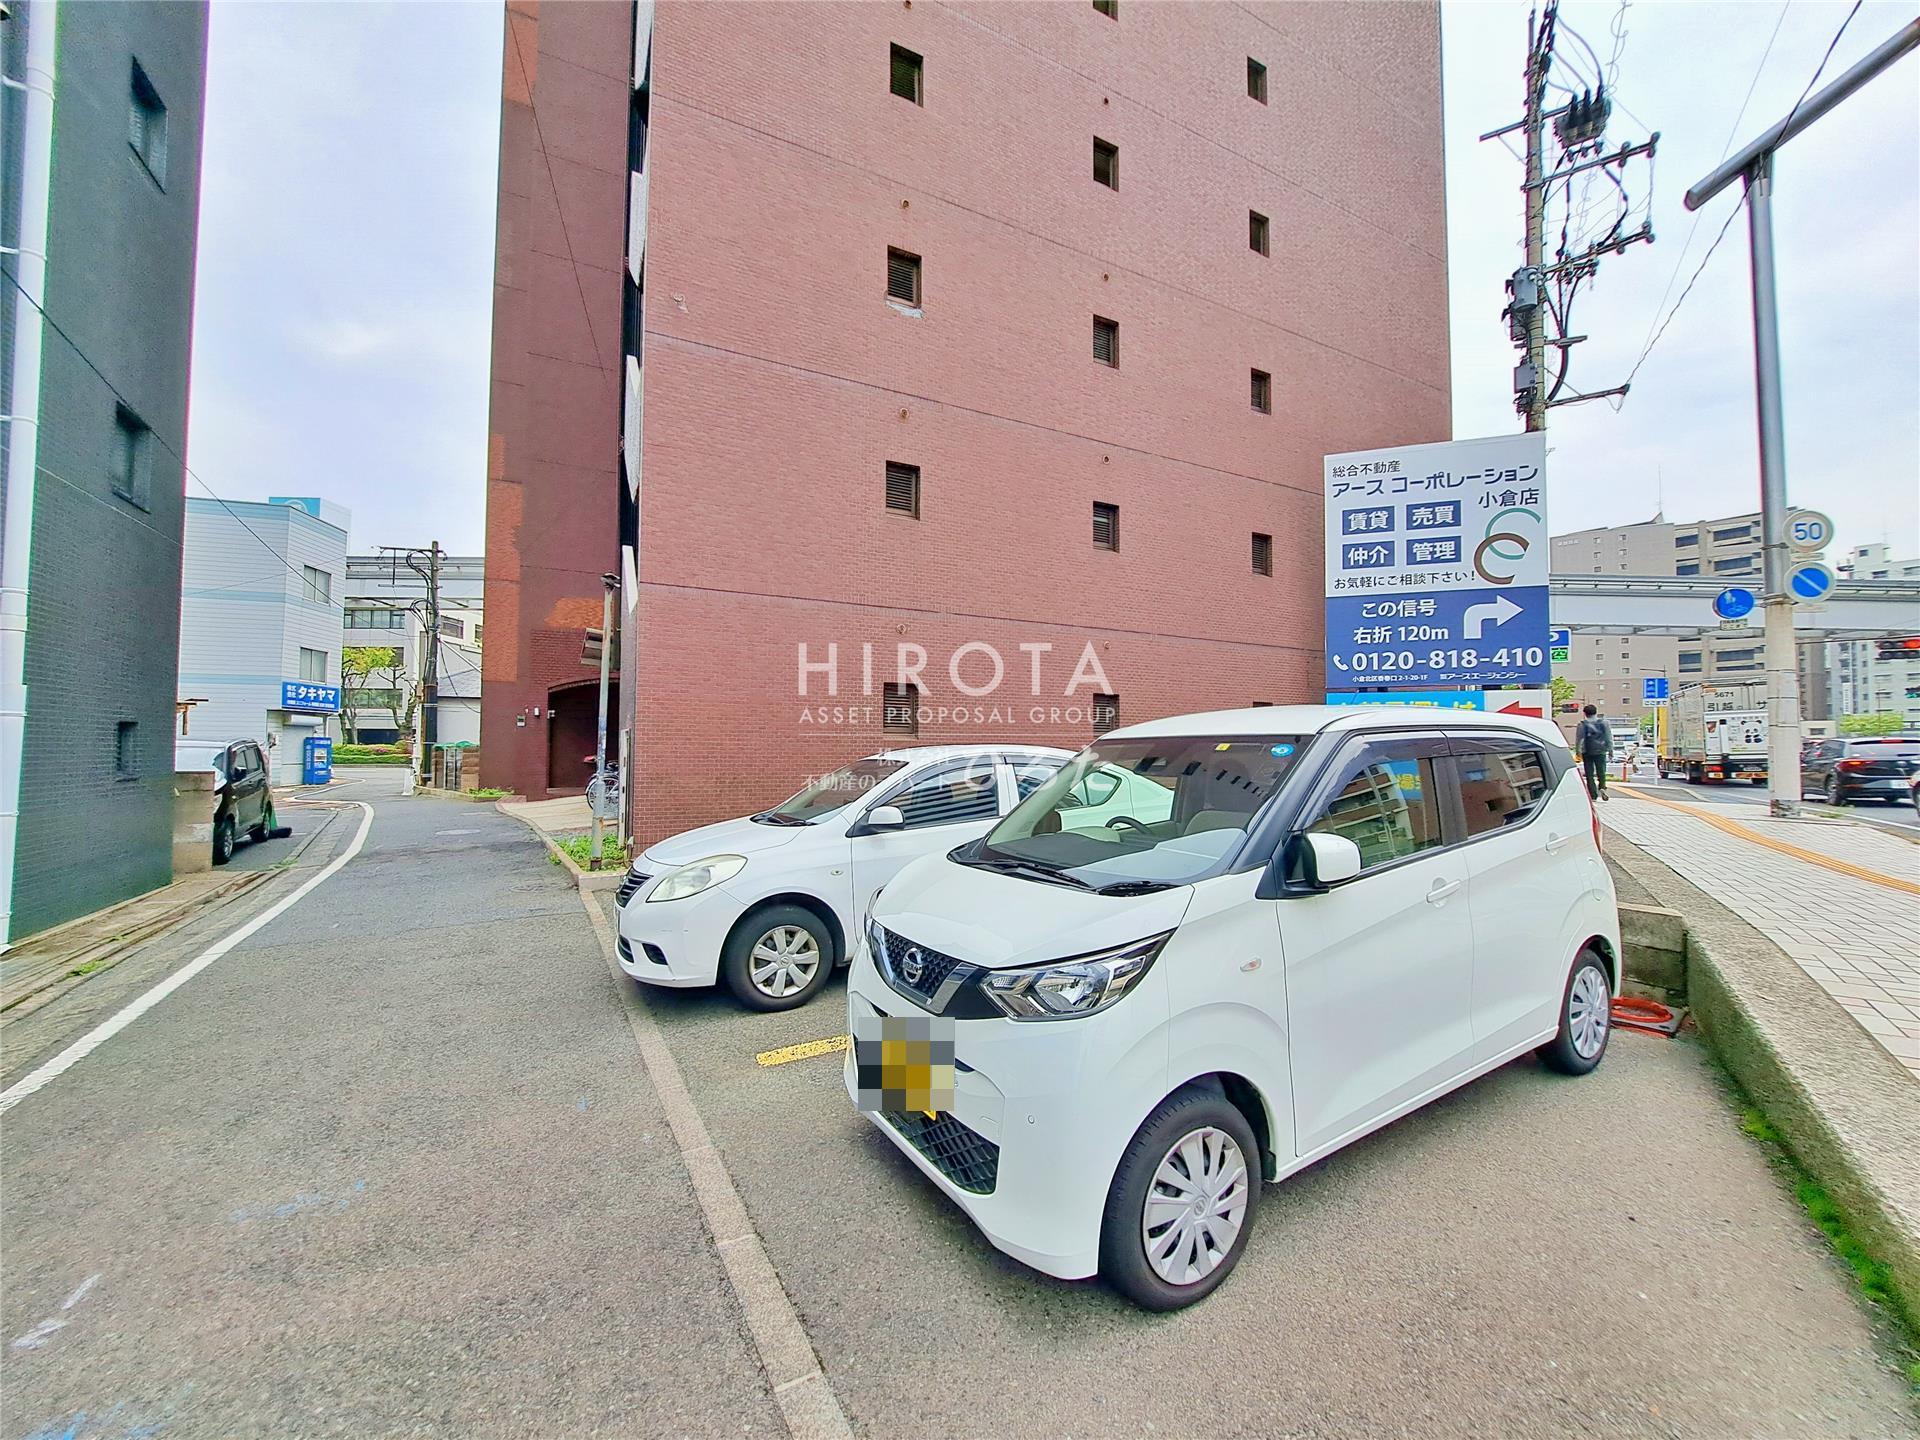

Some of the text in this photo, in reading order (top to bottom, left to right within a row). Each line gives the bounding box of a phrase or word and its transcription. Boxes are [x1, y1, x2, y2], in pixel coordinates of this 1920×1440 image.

[1332, 460, 1401, 478] 総合不動産
[1478, 488, 1539, 508] 小倉店
[1348, 511, 1389, 532] 賃貸
[1412, 505, 1454, 526] 売買
[1794, 522, 1822, 541] 50
[1348, 545, 1389, 566] 仲介
[1413, 541, 1456, 561] 管理
[1361, 599, 1438, 618] この信号
[1353, 625, 1449, 644] 右折 120m
[1352, 647, 1543, 671] 0120-818-410
[299, 686, 336, 701] タキヤマ
